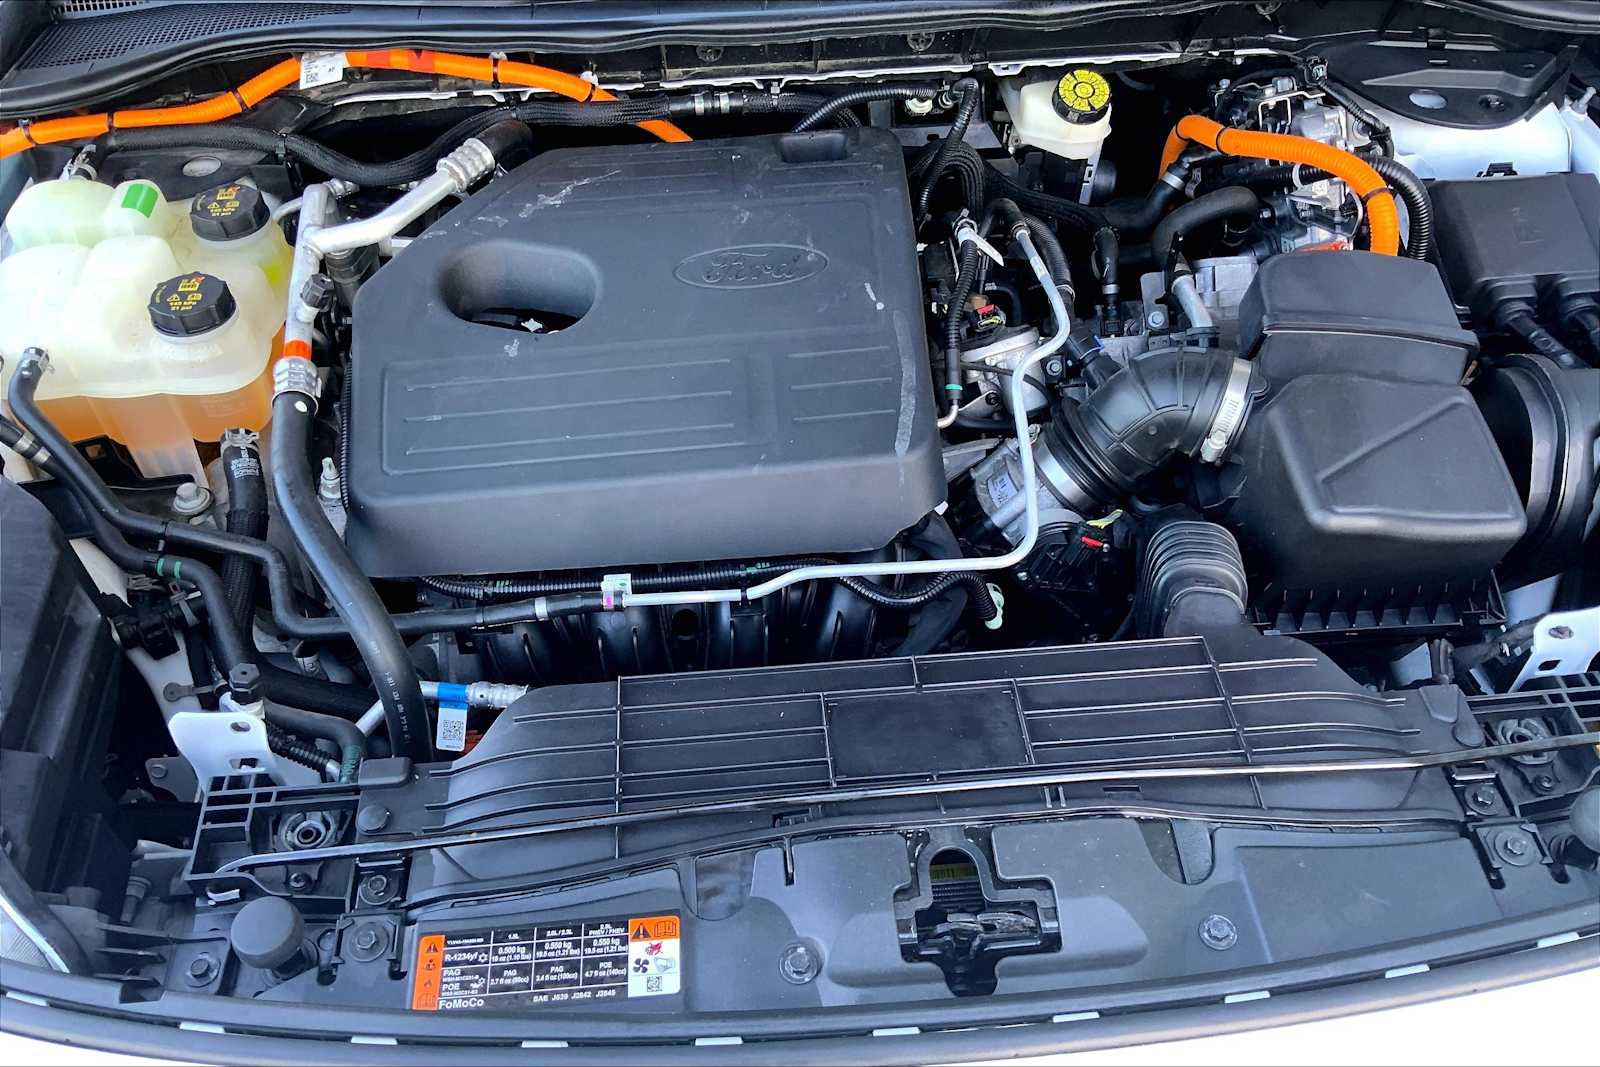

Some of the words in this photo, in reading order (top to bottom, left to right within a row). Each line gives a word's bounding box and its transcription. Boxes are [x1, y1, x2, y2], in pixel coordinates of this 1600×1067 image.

[444, 951, 479, 962] R-1234yf
[443, 968, 461, 977] PAG
[503, 969, 517, 977] PAG
[442, 983, 460, 992] POE
[439, 997, 485, 1010] FoMoCo
